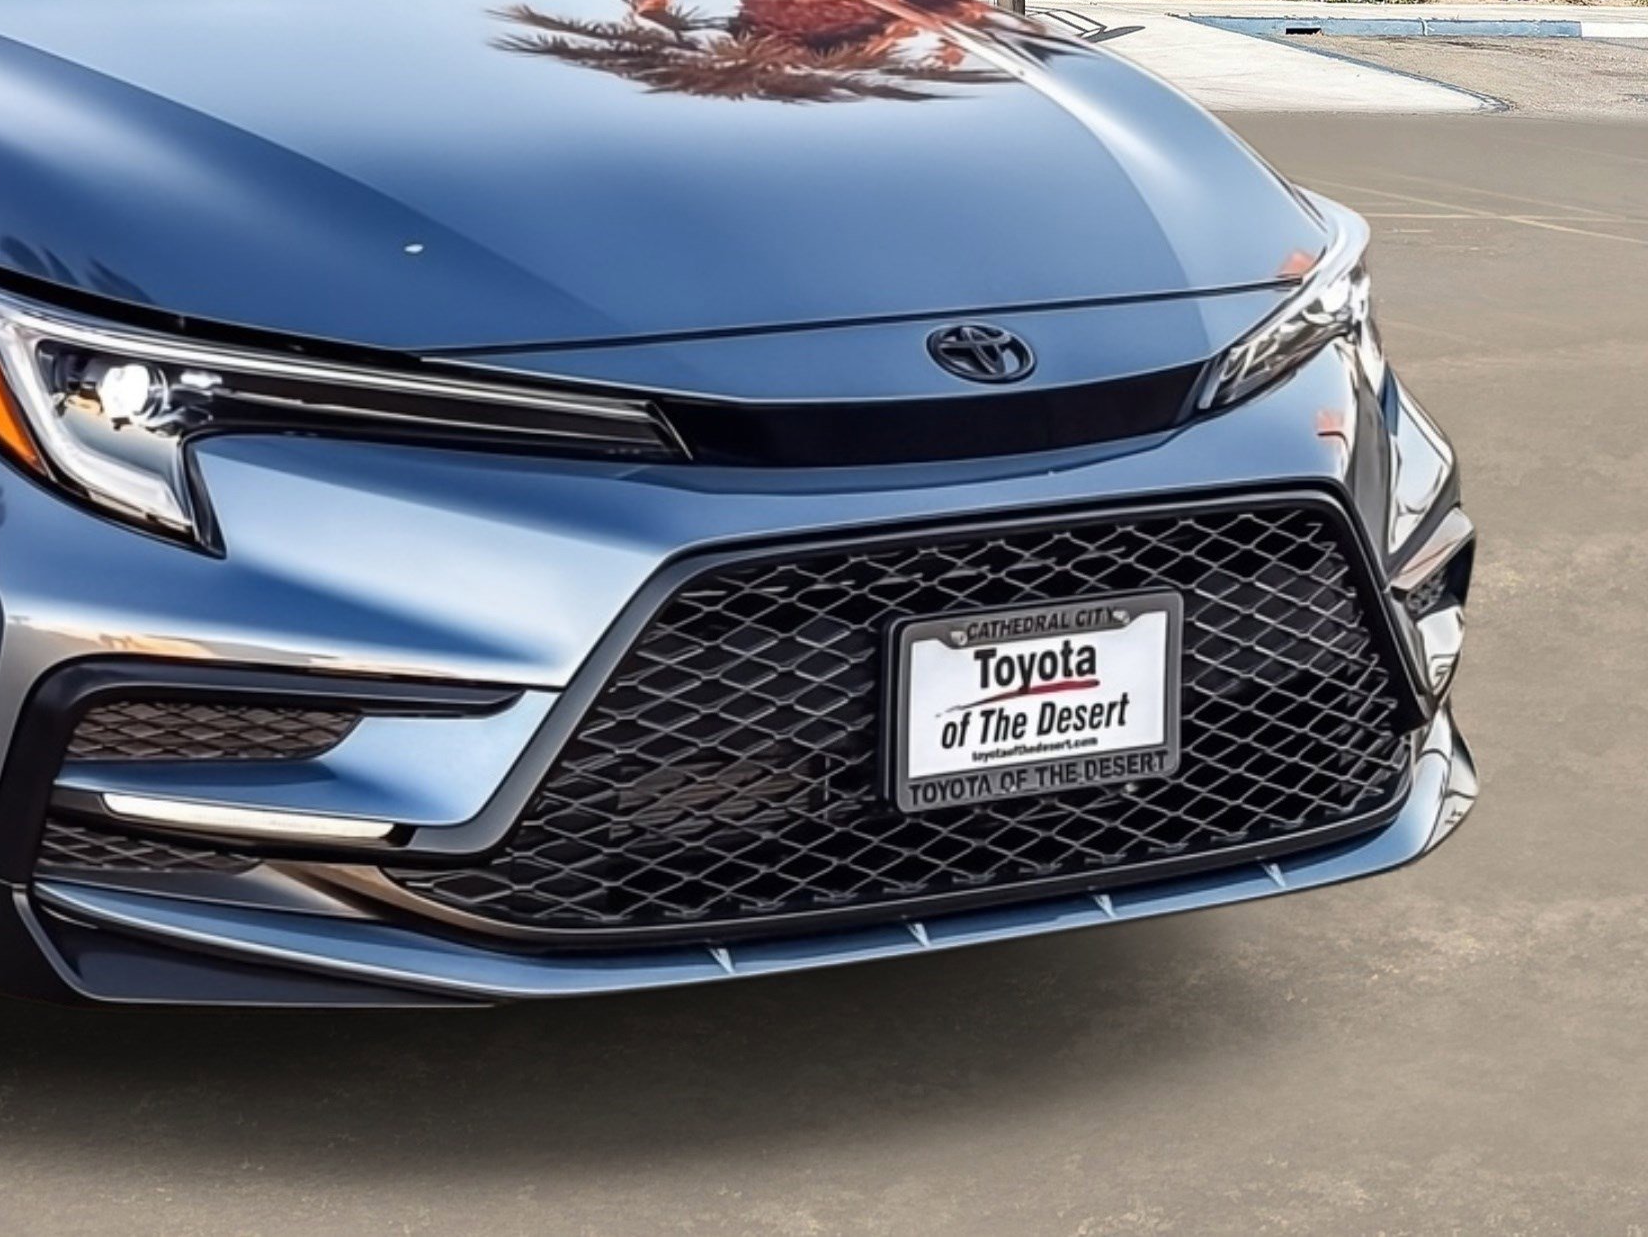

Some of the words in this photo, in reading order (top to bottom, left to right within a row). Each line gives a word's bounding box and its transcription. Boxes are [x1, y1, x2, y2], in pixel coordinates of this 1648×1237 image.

[967, 612, 1069, 641] CATHEDRAL
[974, 640, 1097, 694] Toyota
[941, 712, 972, 750] of
[980, 708, 1027, 745] The
[1036, 692, 1130, 737] Desert
[909, 775, 992, 806] TOYOTA
[1000, 769, 1030, 793] OF
[1033, 763, 1083, 788] THE
[1083, 751, 1169, 781] DESERT
